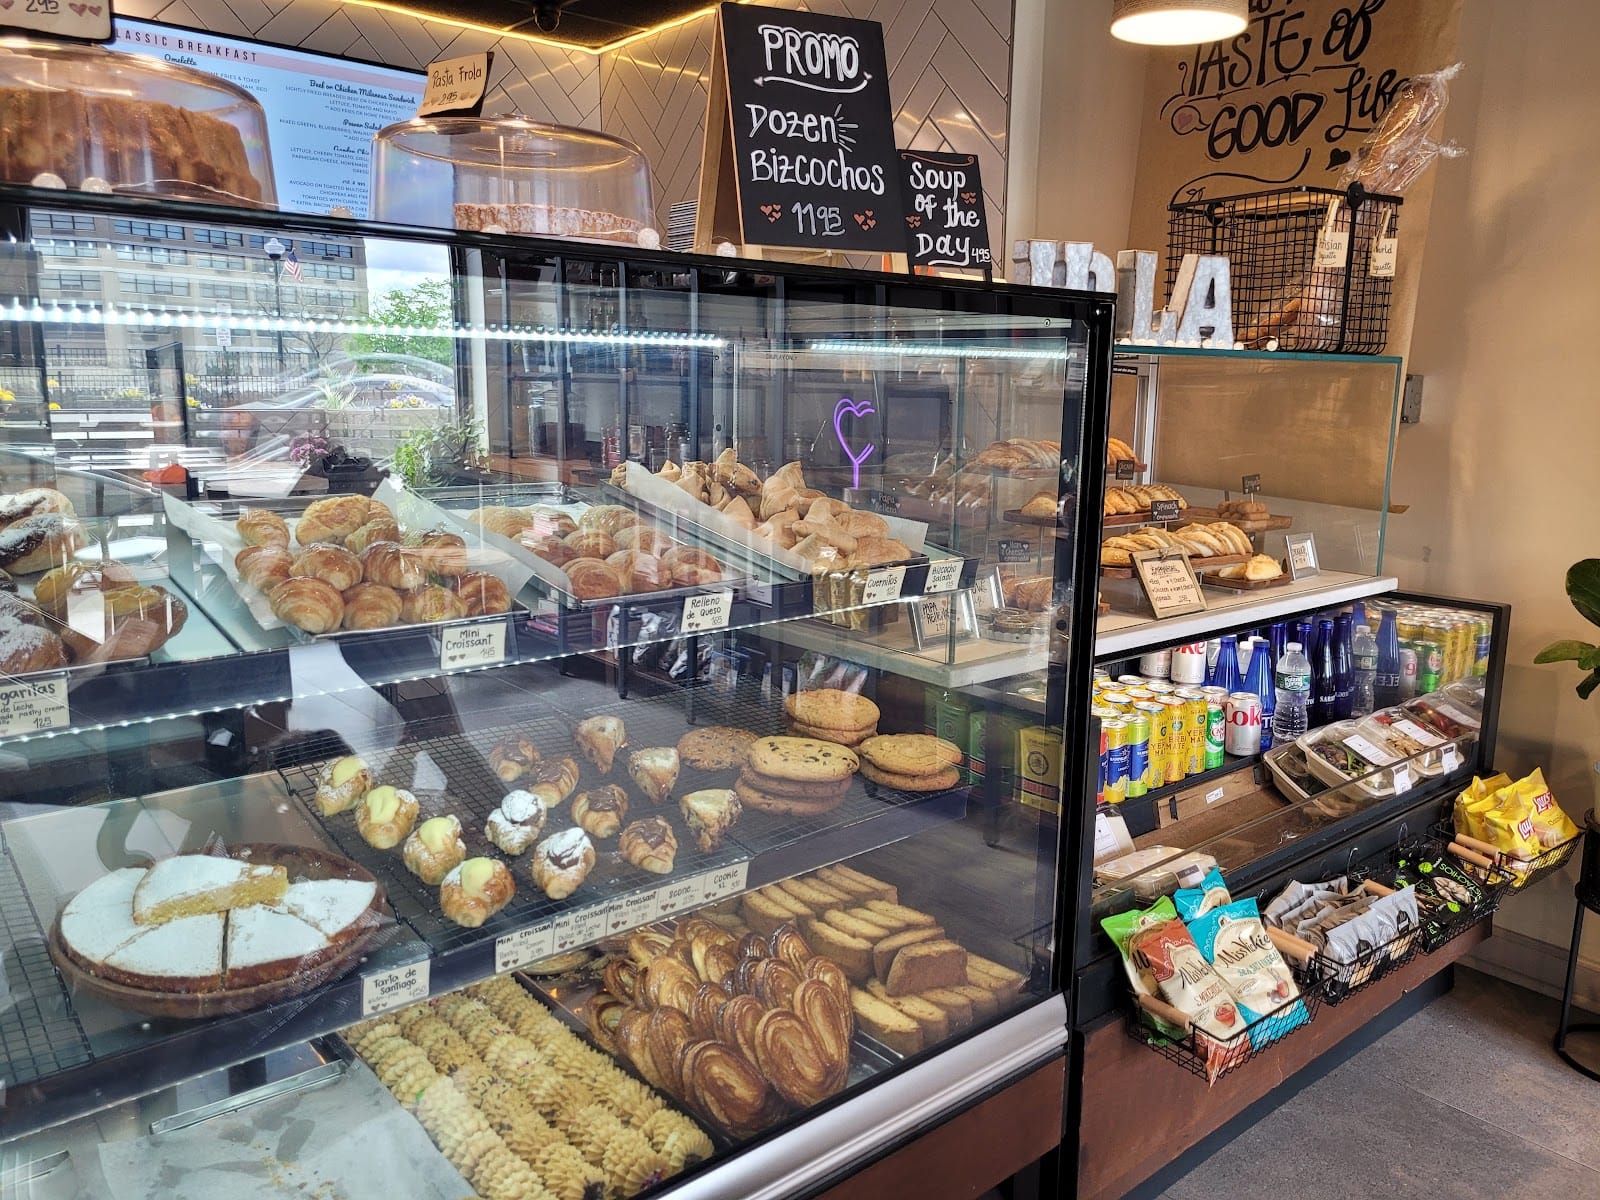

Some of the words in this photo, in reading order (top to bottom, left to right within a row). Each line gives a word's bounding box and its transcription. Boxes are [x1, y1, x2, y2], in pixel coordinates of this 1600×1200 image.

[1322, 0, 1386, 62] of
[114, 29, 168, 48] LASSIC
[178, 39, 257, 63] BREAKFAST
[762, 24, 860, 82] PROMO
[164, 53, 198, 66] Omelette
[432, 66, 454, 89] Pasta
[458, 61, 482, 83] Frola
[309, 79, 325, 89] Beef
[334, 83, 358, 95] Chicken
[388, 93, 416, 105] Sandwich
[364, 121, 382, 131] Salad
[745, 103, 840, 144] Dozen
[1207, 92, 1325, 160] GOOD
[750, 147, 885, 196] Bizcochos
[909, 160, 966, 201] Soup
[791, 202, 846, 236] 1195
[914, 193, 937, 220] of
[943, 198, 980, 229] the
[915, 233, 970, 265] Day
[1156, 501, 1178, 512] Spinach
[867, 573, 898, 588] Cuernitos
[686, 610, 695, 620] de
[700, 606, 722, 617] Queso
[691, 596, 721, 609] Relleno
[445, 633, 495, 651] Croissant
[459, 629, 480, 639] Mini
[1225, 701, 1262, 727] Cok
[625, 891, 657, 908] Croissant
[554, 920, 570, 930] Mini
[575, 906, 609, 924] Croissant
[497, 936, 514, 947] Mini
[519, 921, 554, 939] Croissant
[374, 974, 399, 988] Tarta
[405, 968, 417, 979] de
[380, 978, 417, 995] Santiago
